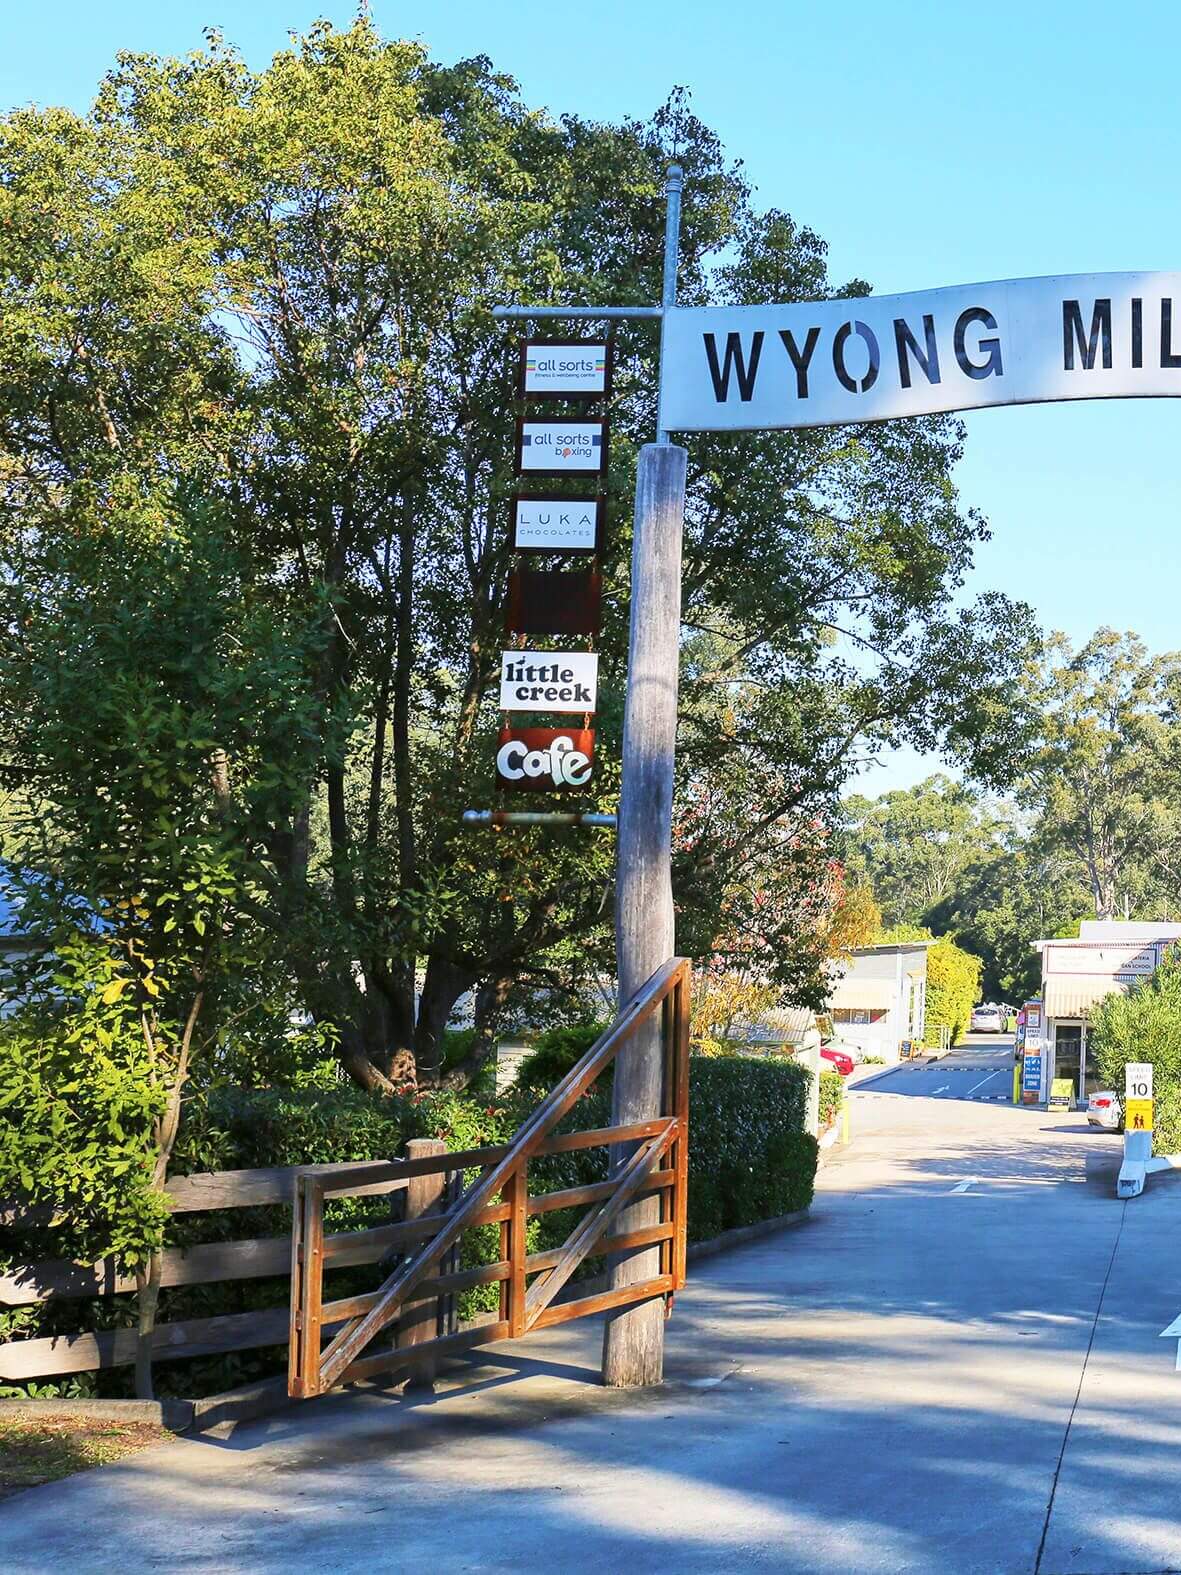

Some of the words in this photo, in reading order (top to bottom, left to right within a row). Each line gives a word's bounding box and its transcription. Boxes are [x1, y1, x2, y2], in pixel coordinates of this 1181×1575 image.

[703, 307, 1003, 403] WYONG
[538, 360, 556, 371] all
[559, 360, 593, 371] sorts
[534, 433, 552, 445] all
[556, 433, 590, 445] sorts
[520, 514, 592, 525] LUKA
[505, 661, 574, 683] little
[515, 683, 593, 702] creek
[496, 736, 593, 786] Cafe
[1131, 1082, 1148, 1097] 10
